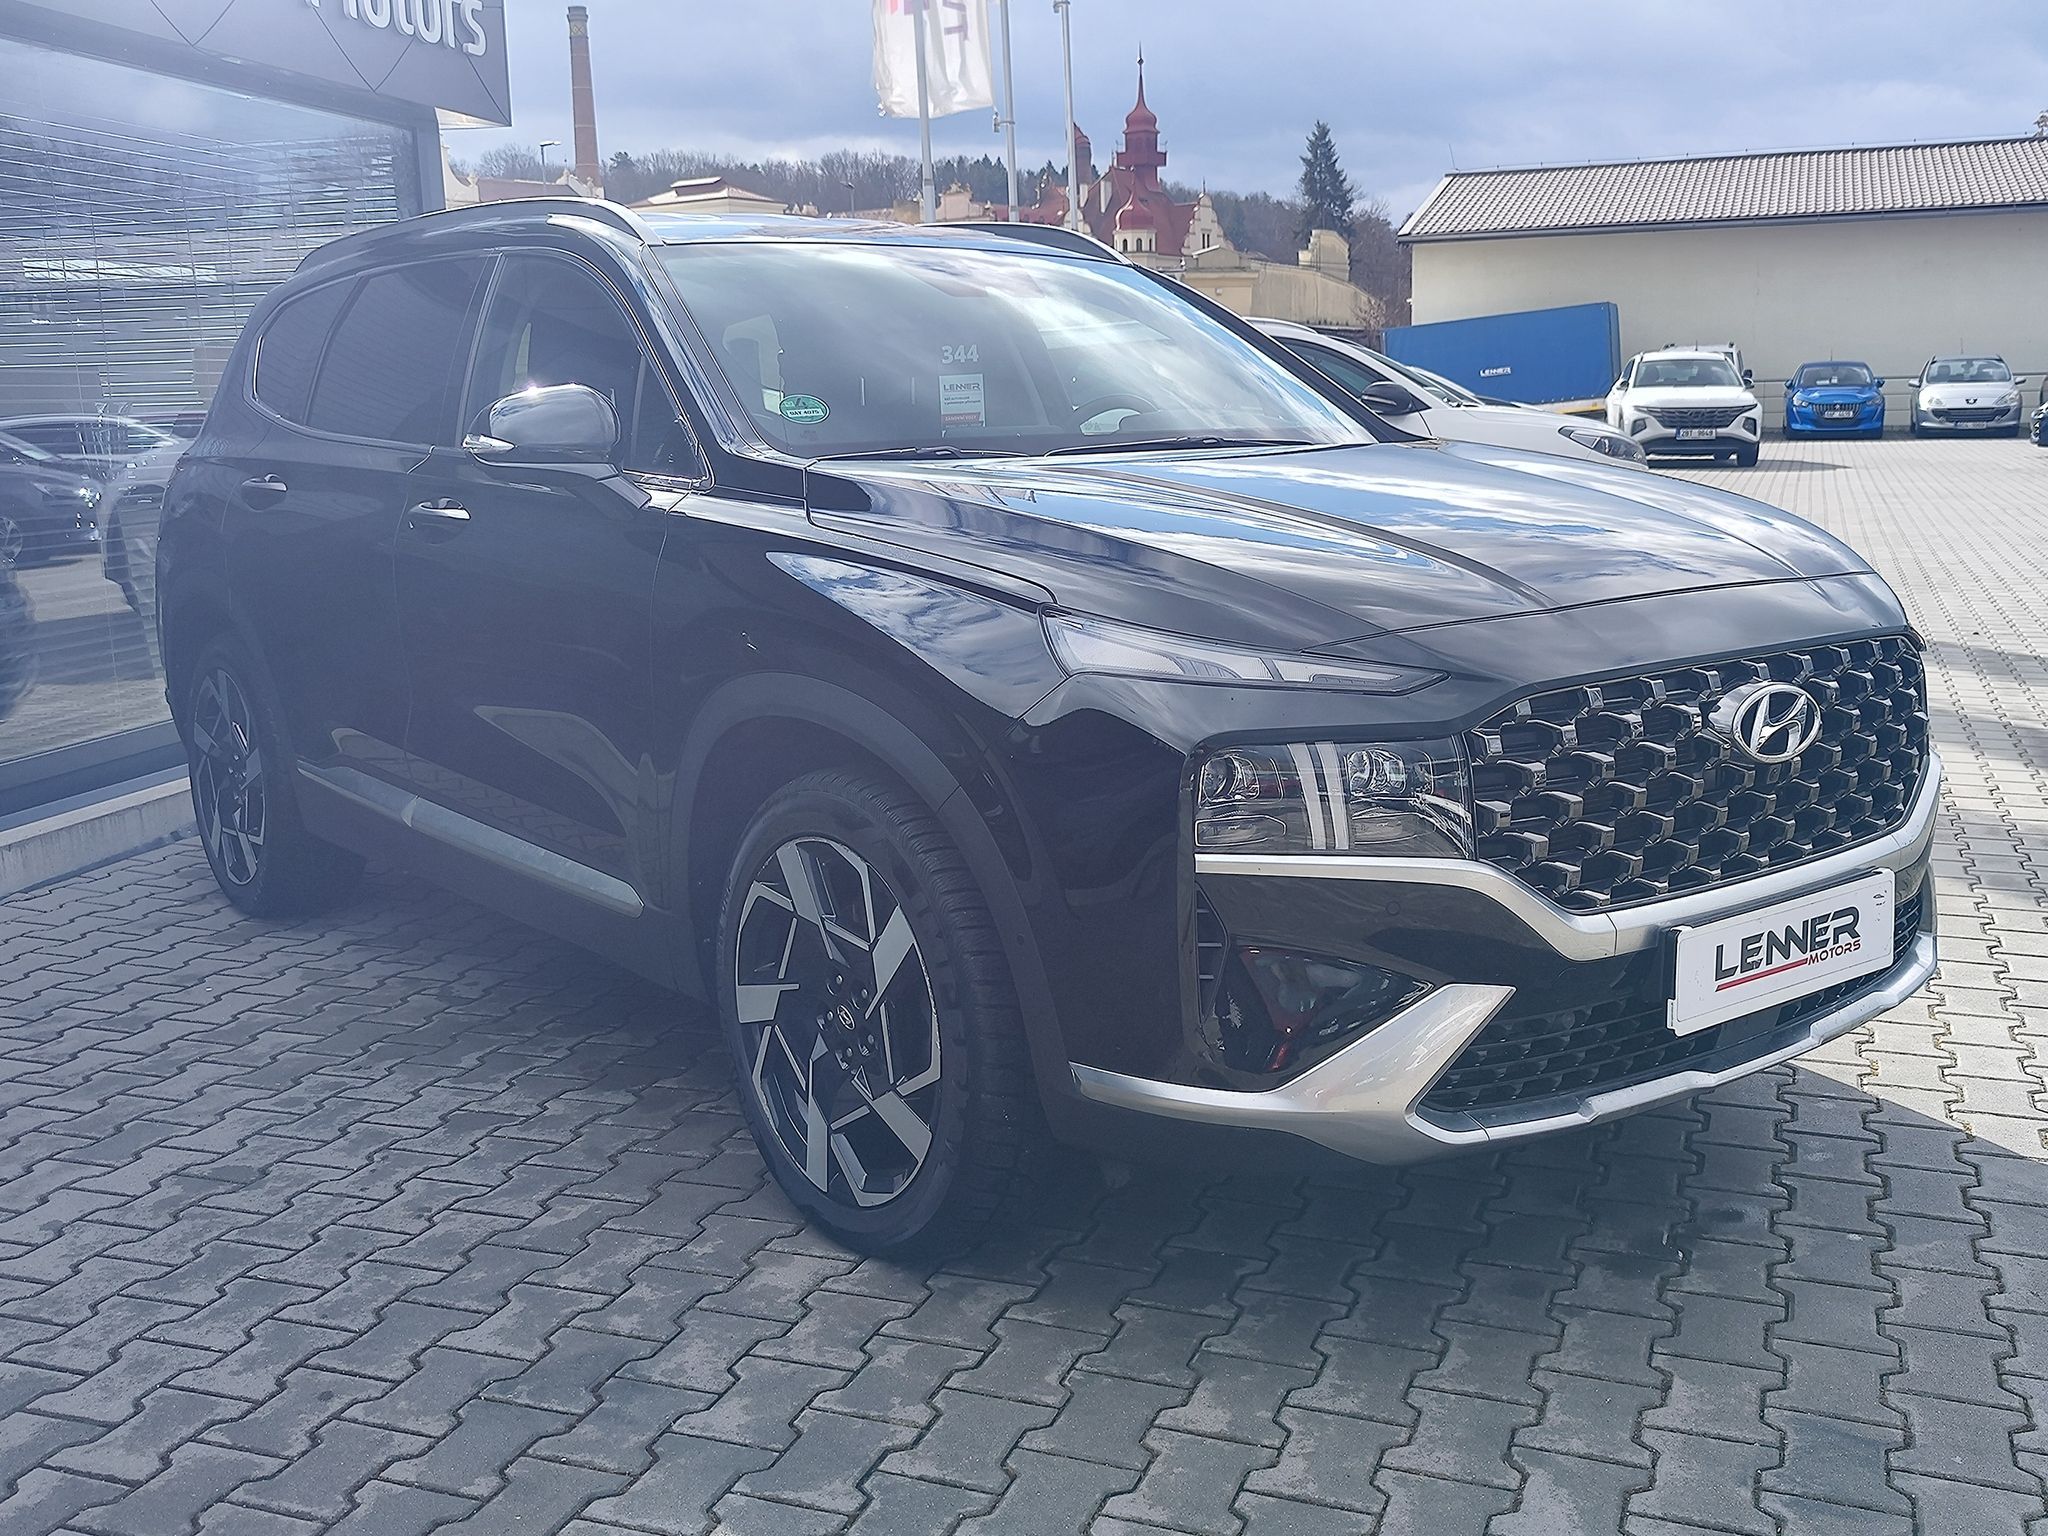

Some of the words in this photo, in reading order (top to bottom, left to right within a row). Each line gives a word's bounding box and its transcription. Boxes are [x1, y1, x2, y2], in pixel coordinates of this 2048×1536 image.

[306, 0, 487, 56] otors
[942, 344, 979, 364] 344
[943, 382, 981, 392] LENNER
[1715, 906, 1860, 982] LENNER
[1807, 939, 1861, 966] MOTORS
